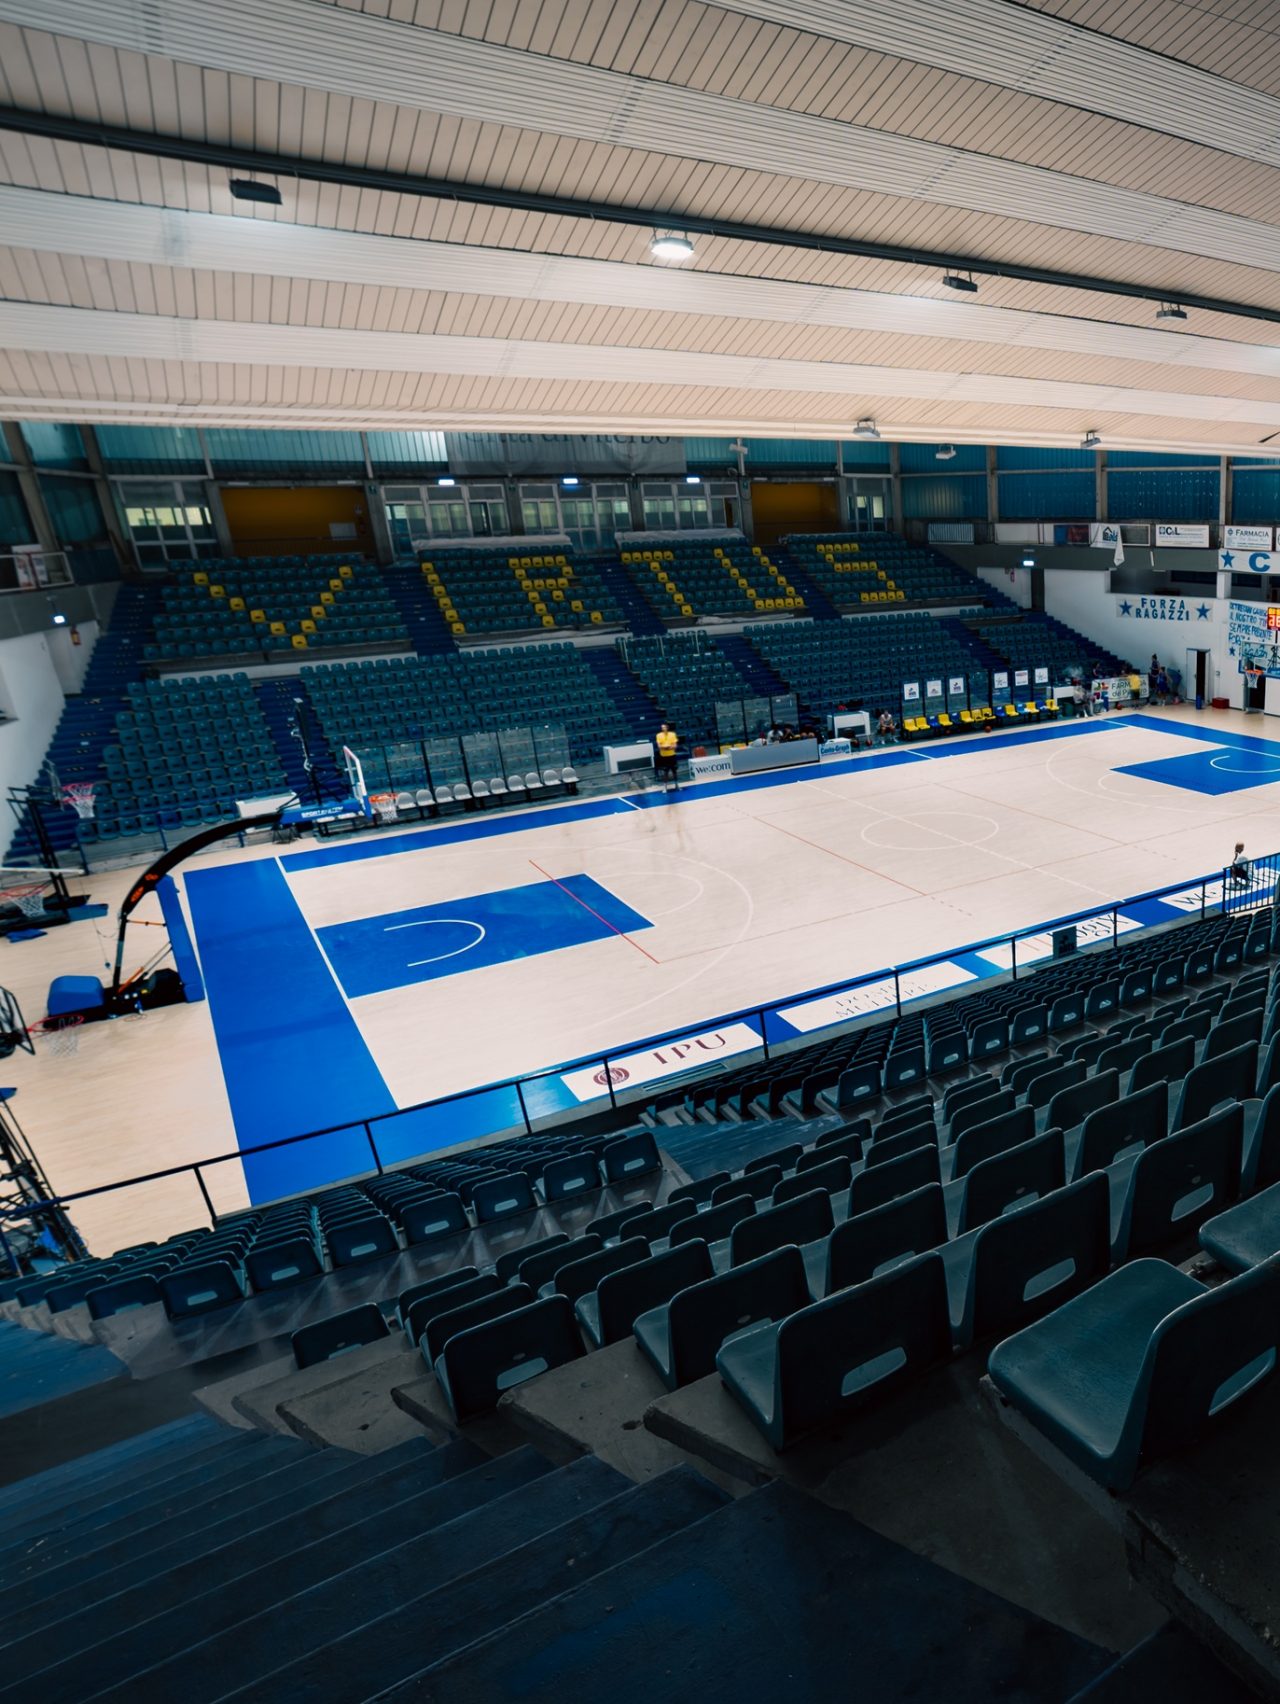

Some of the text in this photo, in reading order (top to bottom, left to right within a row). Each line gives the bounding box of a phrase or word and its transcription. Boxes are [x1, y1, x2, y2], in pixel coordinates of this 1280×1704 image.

[1235, 529, 1269, 538] FARMACIA
[1141, 597, 1186, 610] FORZA
[1135, 608, 1190, 621] RAGAZZI
[652, 1033, 727, 1065] IPU
